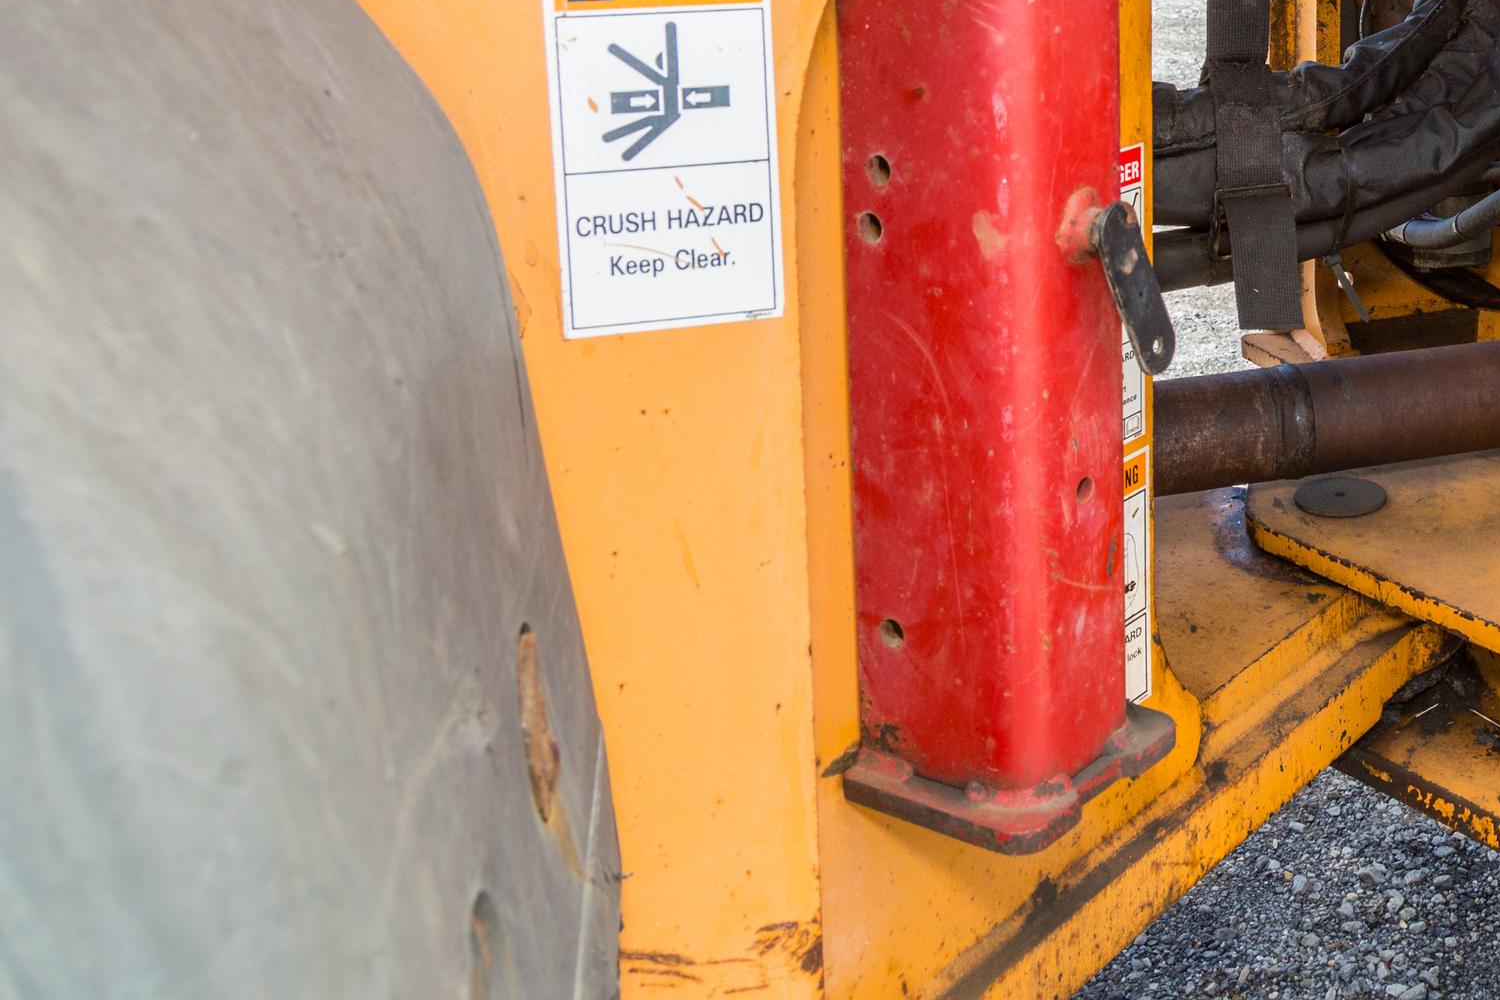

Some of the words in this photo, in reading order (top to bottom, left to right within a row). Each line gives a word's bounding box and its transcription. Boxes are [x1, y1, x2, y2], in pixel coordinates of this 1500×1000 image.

[576, 211, 657, 238] CRUSH
[667, 203, 765, 230] HAZARD
[610, 255, 664, 279] Keep
[675, 249, 737, 271] Clear.
